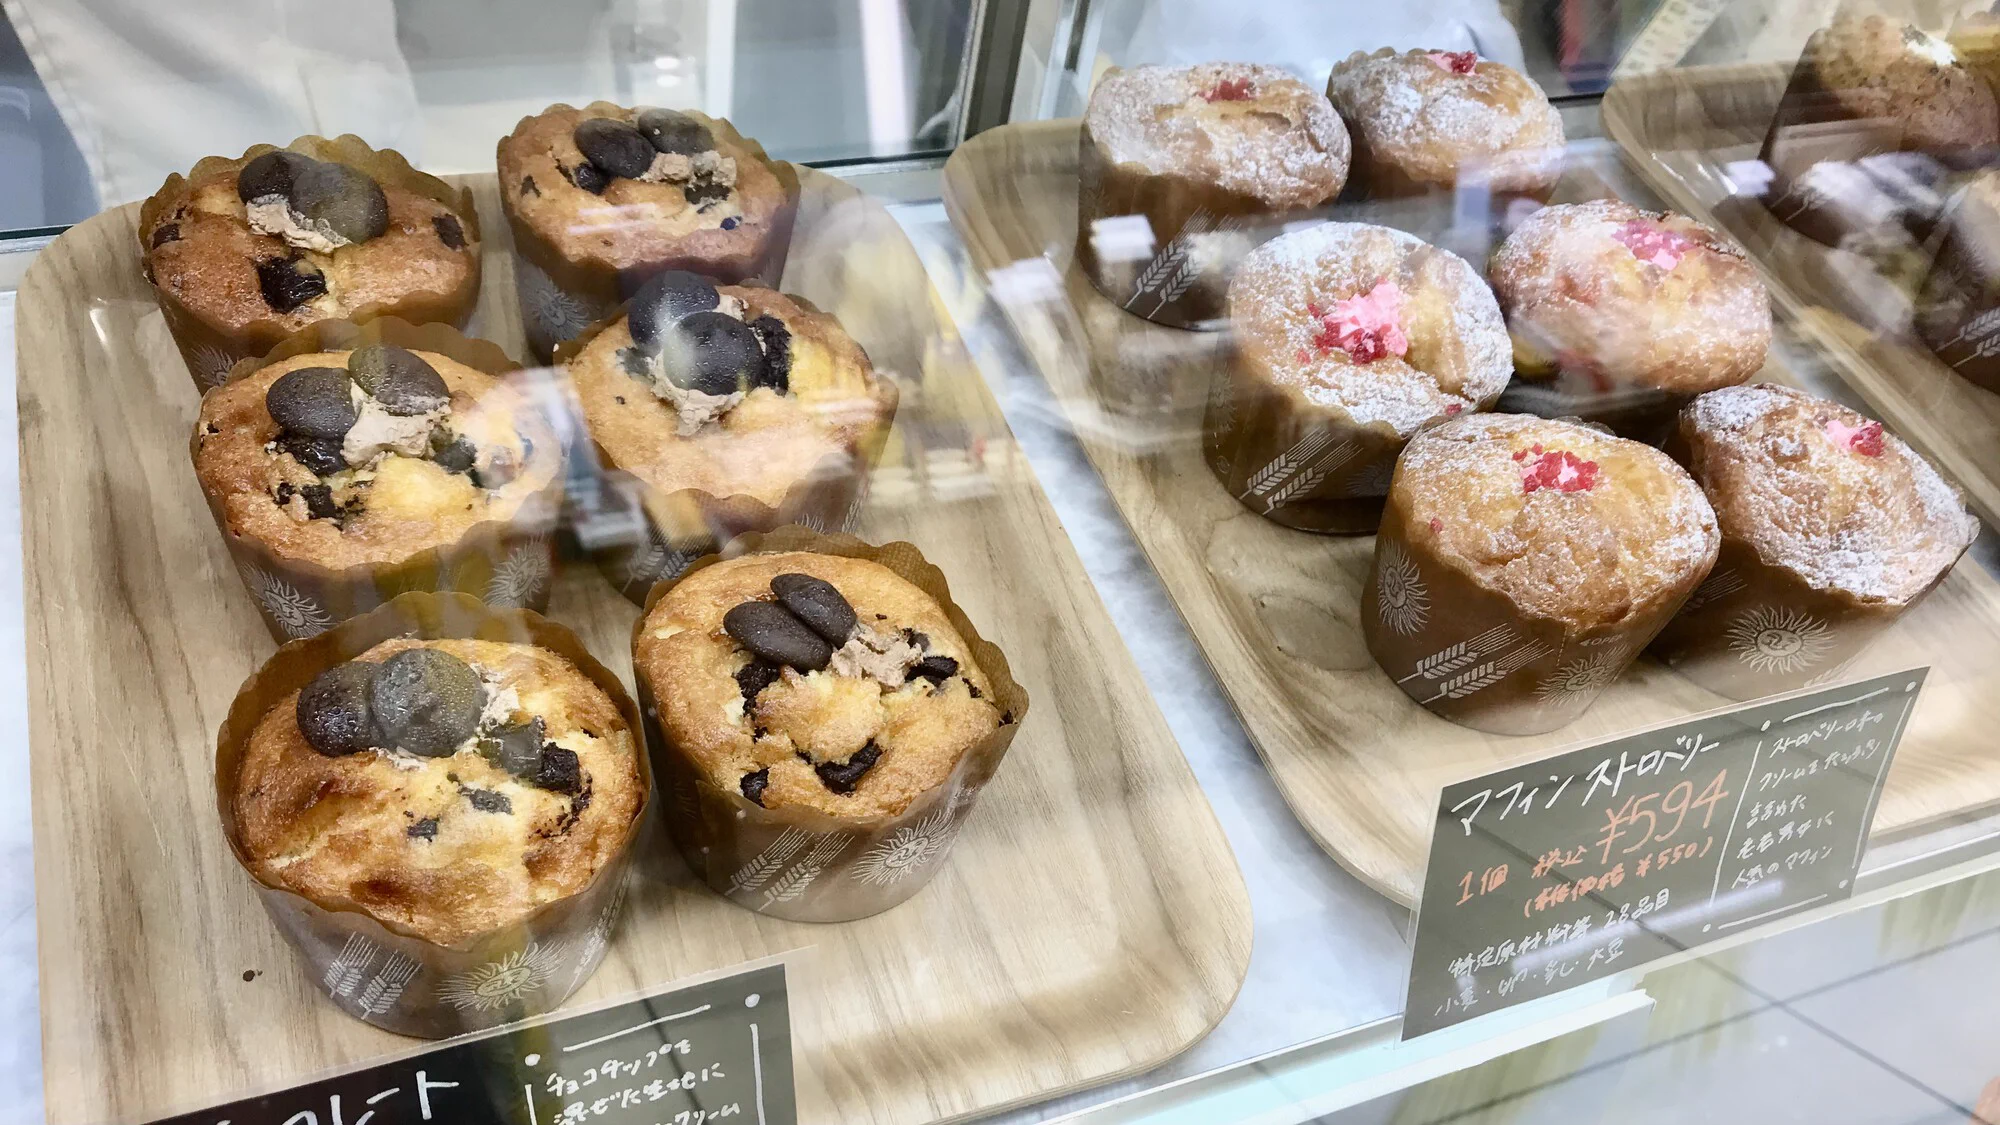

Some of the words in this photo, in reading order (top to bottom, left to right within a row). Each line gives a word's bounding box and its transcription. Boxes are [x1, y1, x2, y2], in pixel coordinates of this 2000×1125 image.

[1450, 773, 1575, 836] マフィン
[1580, 733, 1720, 807] ストロベリー
